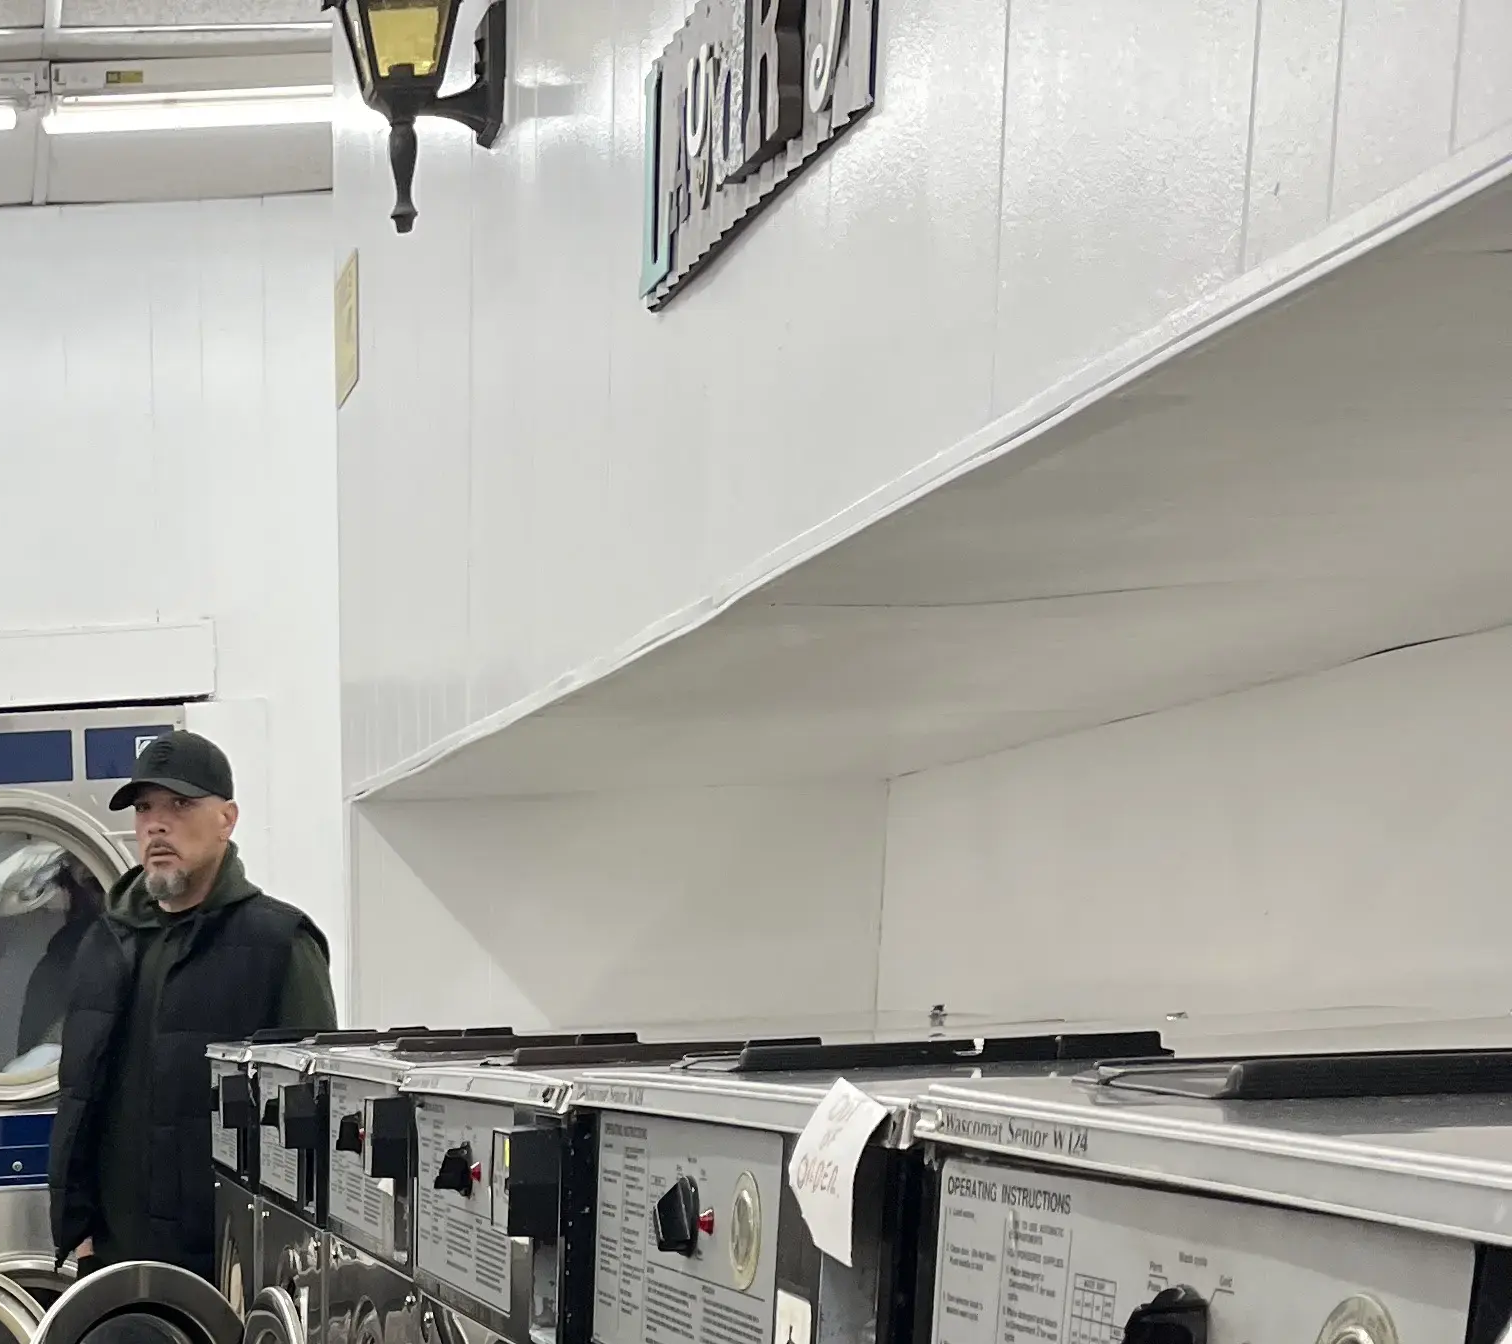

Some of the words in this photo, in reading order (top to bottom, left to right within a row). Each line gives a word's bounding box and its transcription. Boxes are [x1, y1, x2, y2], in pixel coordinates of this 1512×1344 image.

[1008, 1116, 1049, 1148] Senior
[947, 1175, 998, 1203] OPERATING
[1001, 1182, 1072, 1215] INSTRUCTIONS
